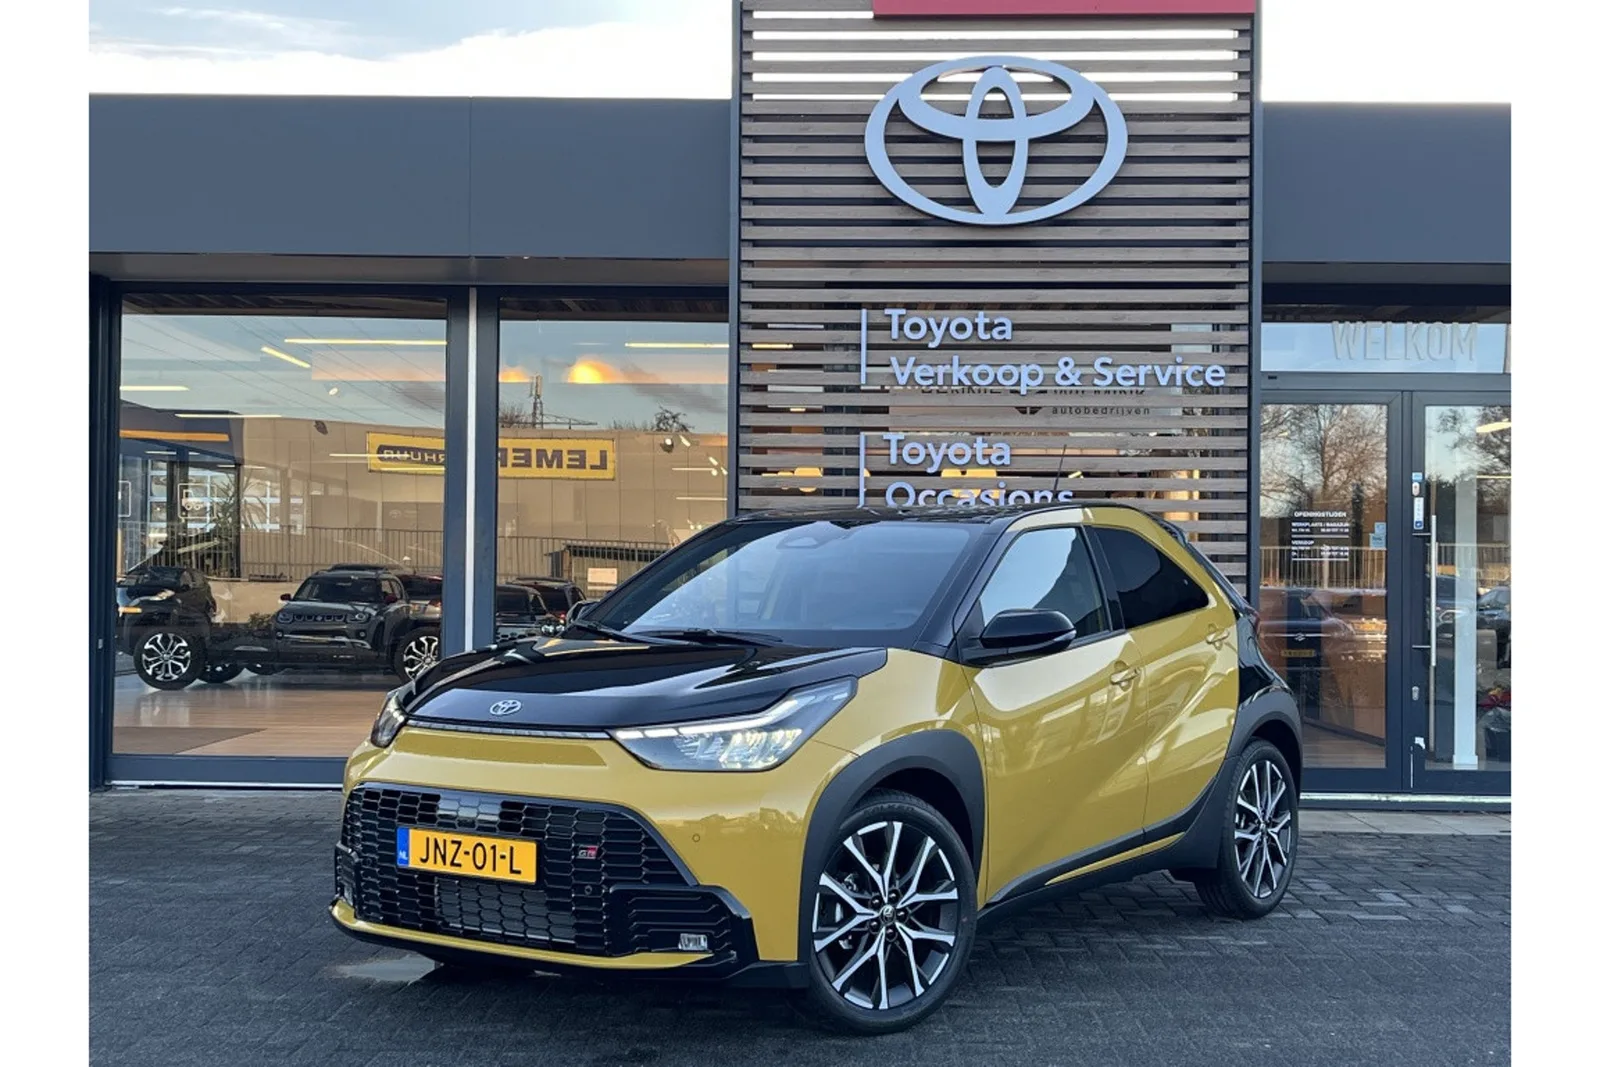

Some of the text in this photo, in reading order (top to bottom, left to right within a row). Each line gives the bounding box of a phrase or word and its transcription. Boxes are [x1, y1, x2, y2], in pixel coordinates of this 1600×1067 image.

[884, 308, 1012, 348] Toyota
[1331, 320, 1479, 361] WELKOM
[889, 355, 1227, 395] Verkoop & Service
[1051, 406, 1151, 416] autobedrijven
[882, 433, 1011, 473] Toyota
[885, 481, 1074, 507] Occasions
[420, 836, 522, 875] JNZ-01-L
